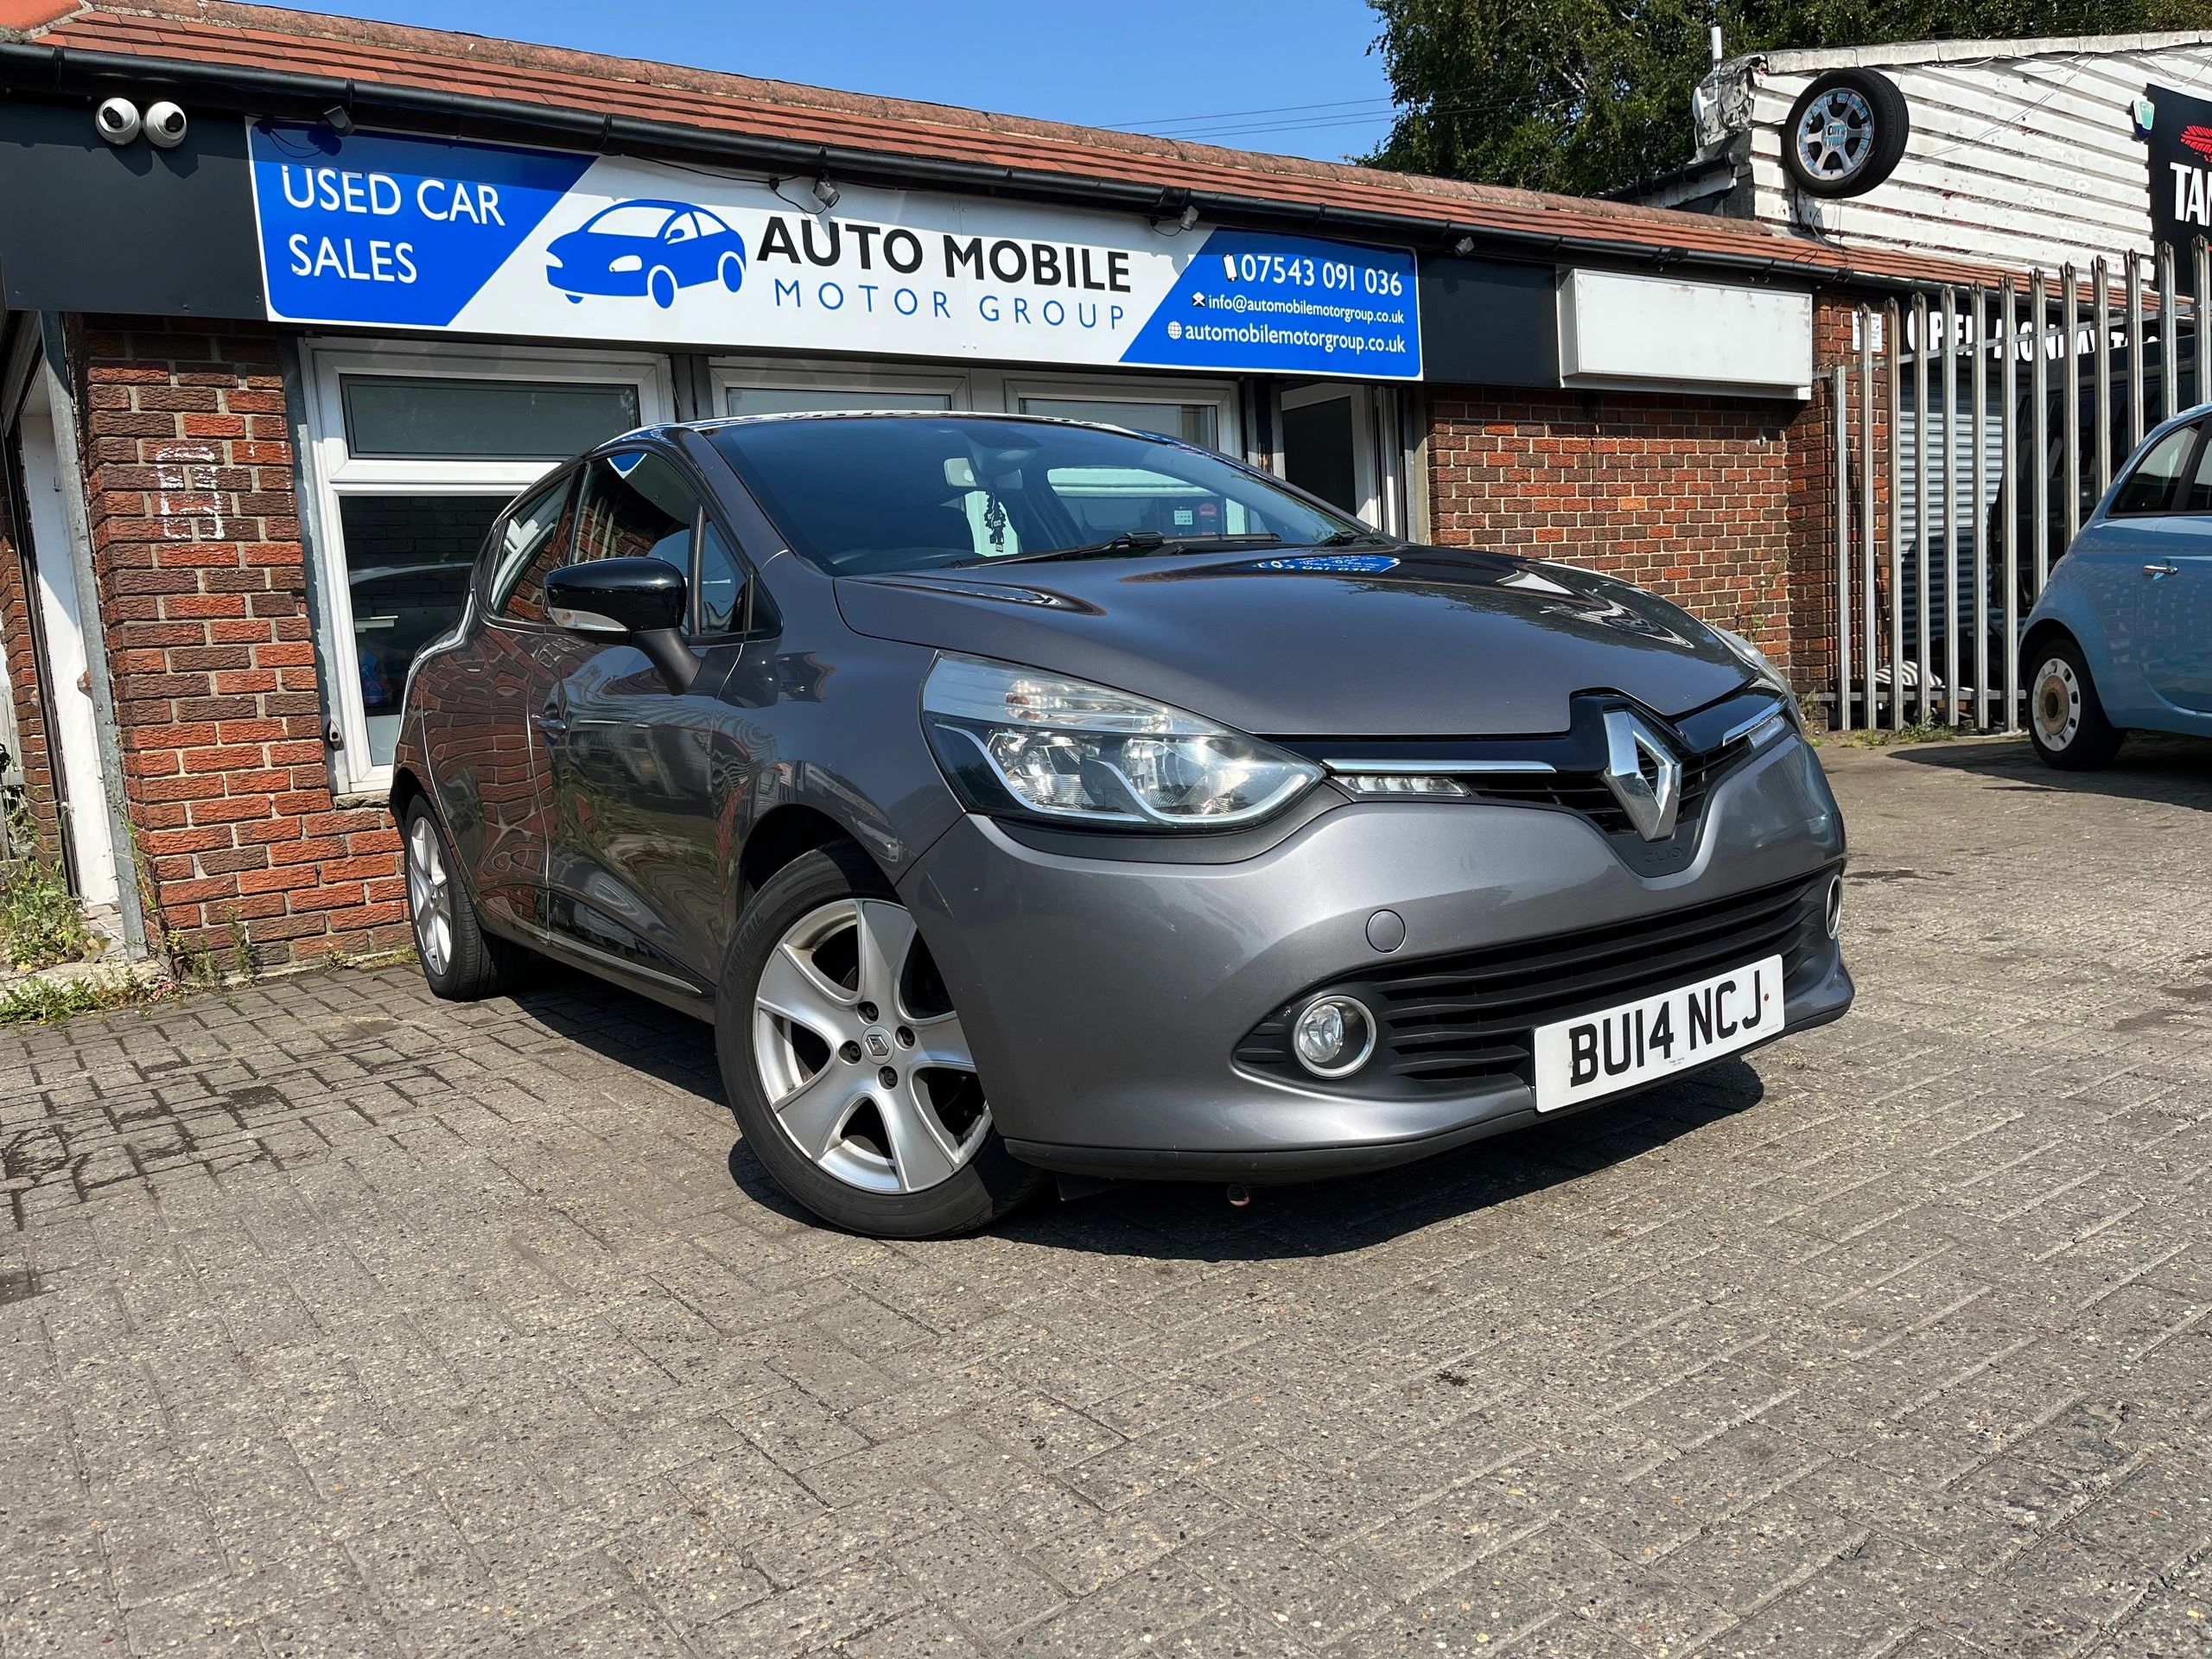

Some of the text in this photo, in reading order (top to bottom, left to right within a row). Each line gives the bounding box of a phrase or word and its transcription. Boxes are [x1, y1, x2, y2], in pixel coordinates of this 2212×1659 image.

[282, 164, 505, 226] USED CAR
[289, 233, 417, 284] SALES
[756, 216, 1131, 293] AUTO MOBILE
[1241, 253, 1403, 296] 07543 091 036
[774, 278, 1124, 331] MOTOR GROUP
[1209, 294, 1405, 324] info@automobilemotorgroup.co.uk
[1185, 322, 1407, 355] automobilemotorgroup.co.uk
[1644, 847, 1683, 863] CLIO
[1568, 969, 1762, 1088] BU14 NCJ
